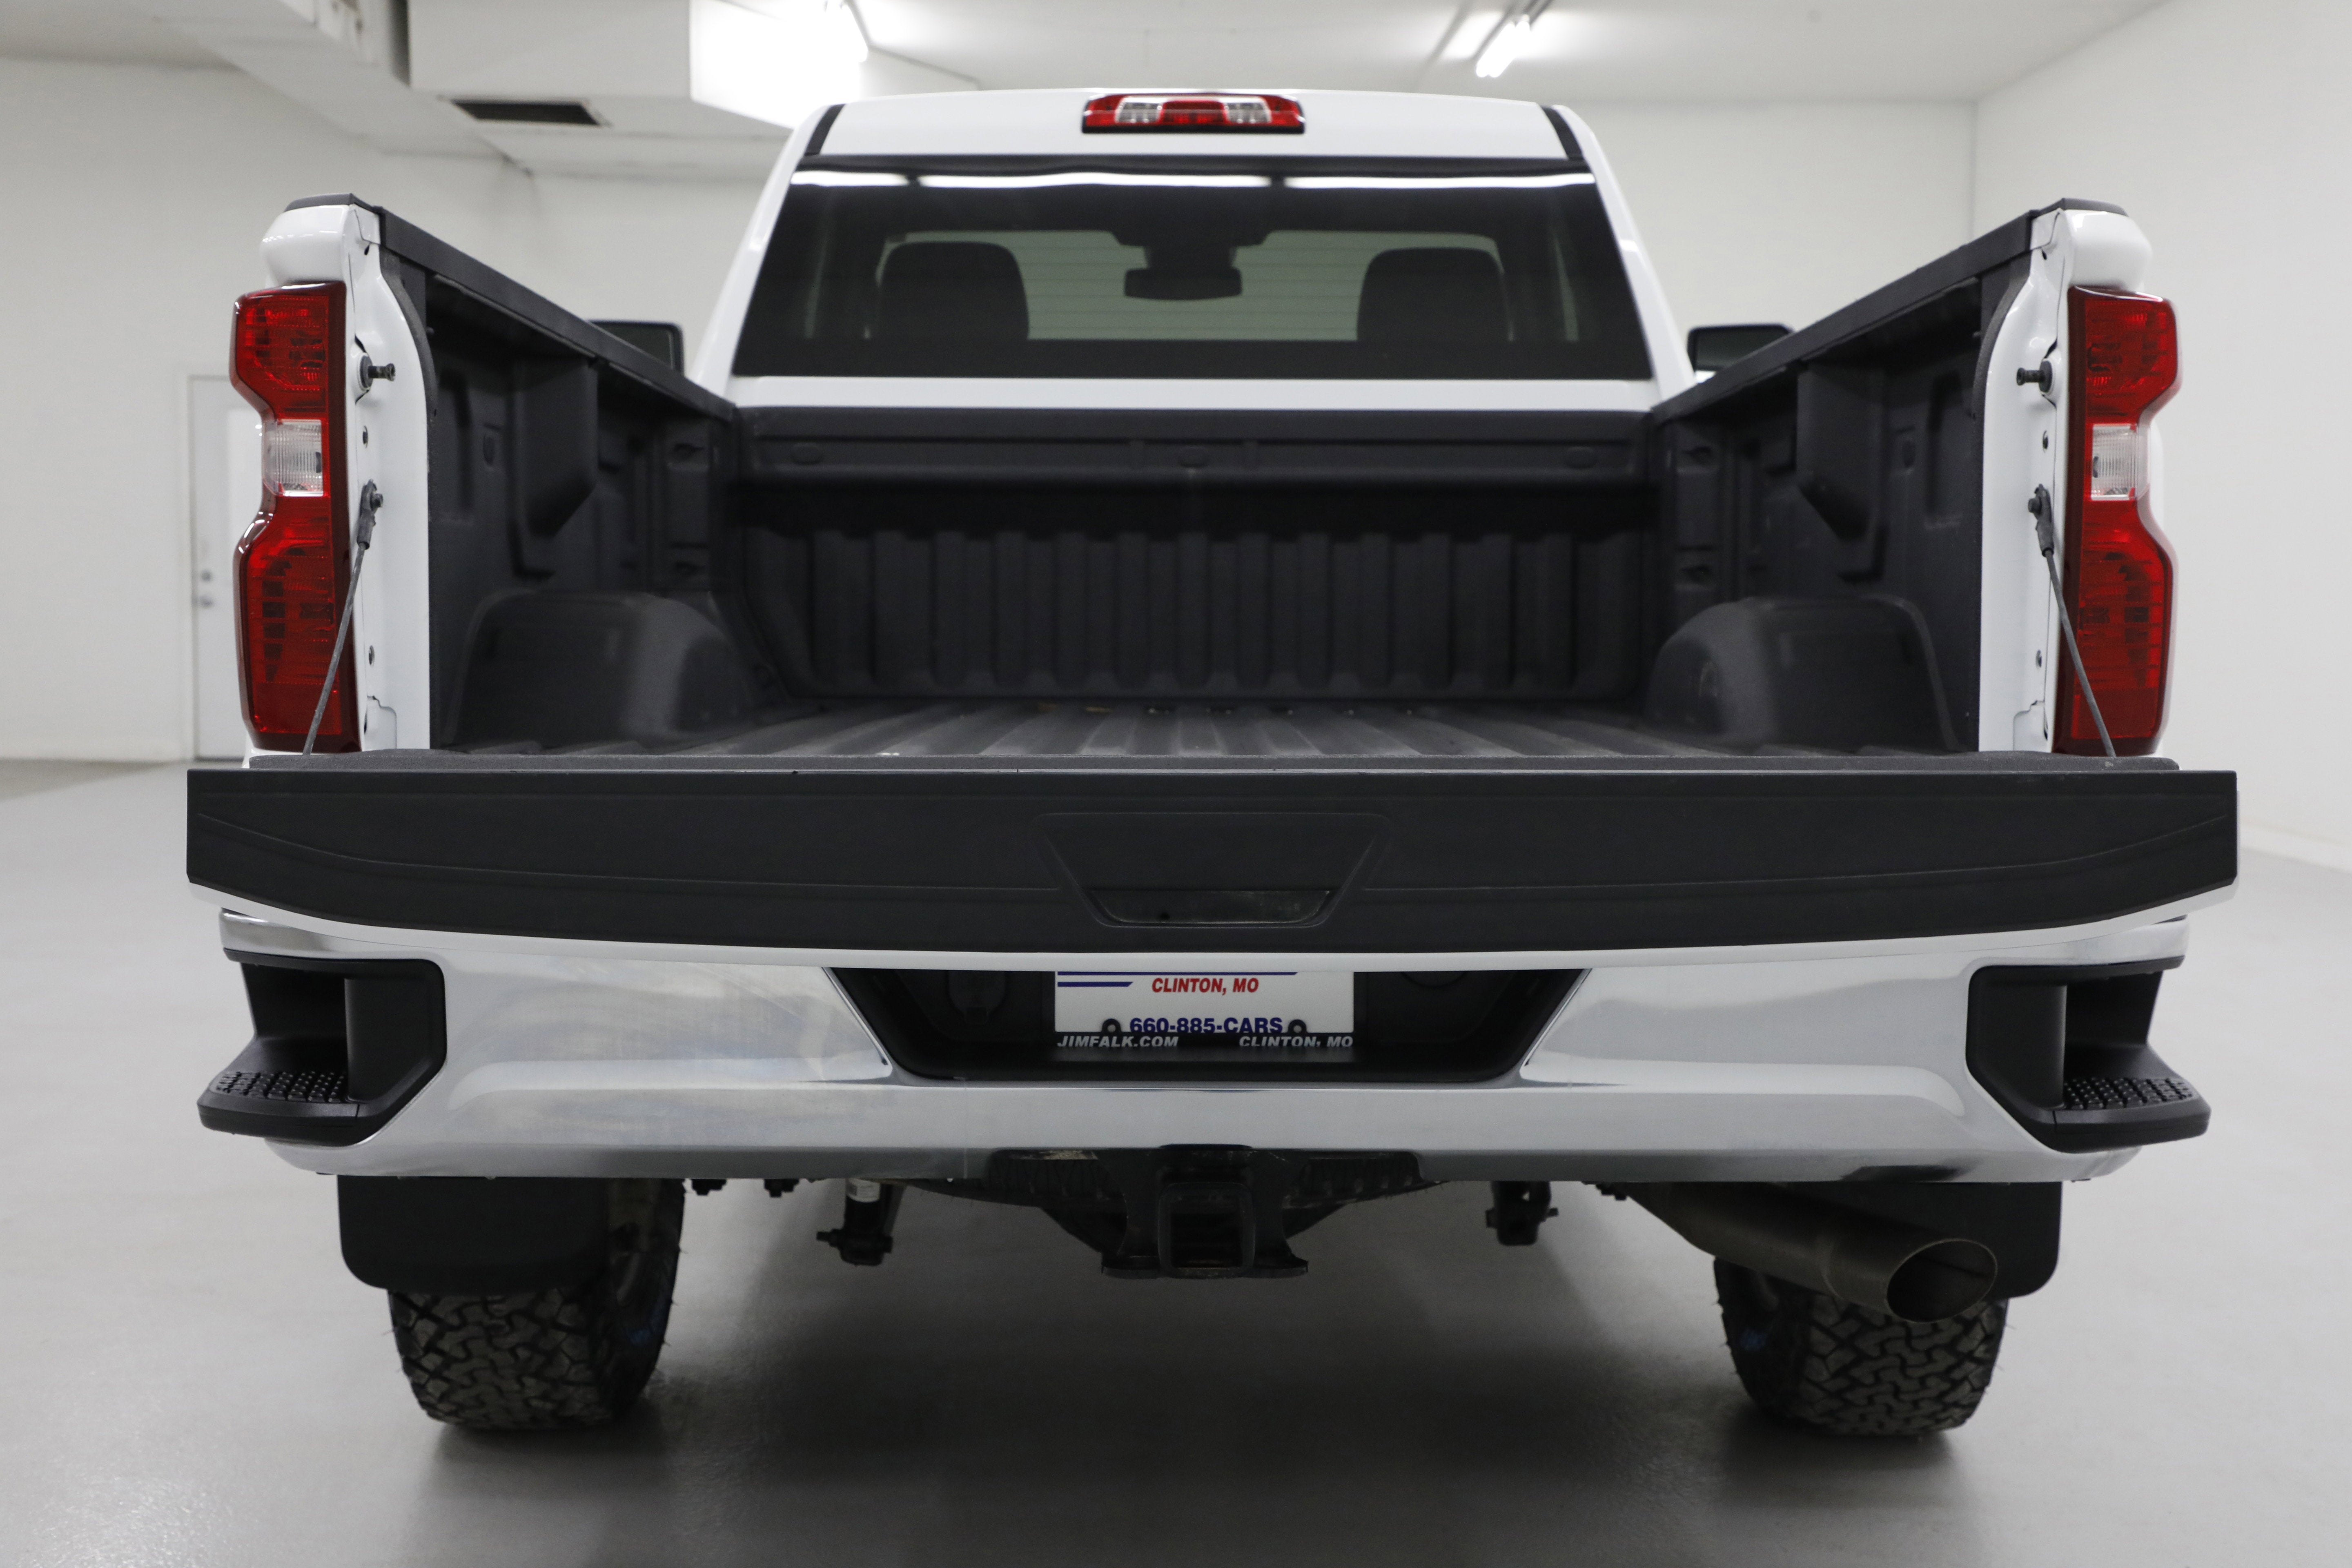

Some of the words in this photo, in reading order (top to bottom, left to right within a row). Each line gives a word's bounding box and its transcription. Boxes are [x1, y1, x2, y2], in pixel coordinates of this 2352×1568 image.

[1152, 978, 1226, 995] CLINTON,
[1233, 978, 1259, 993] MO
[1130, 1018, 1283, 1033] 660-885-CARS
[1057, 1036, 1179, 1047] JIMFALK.COM
[1239, 1036, 1321, 1047] CLINTON,
[1327, 1036, 1353, 1047] MO
